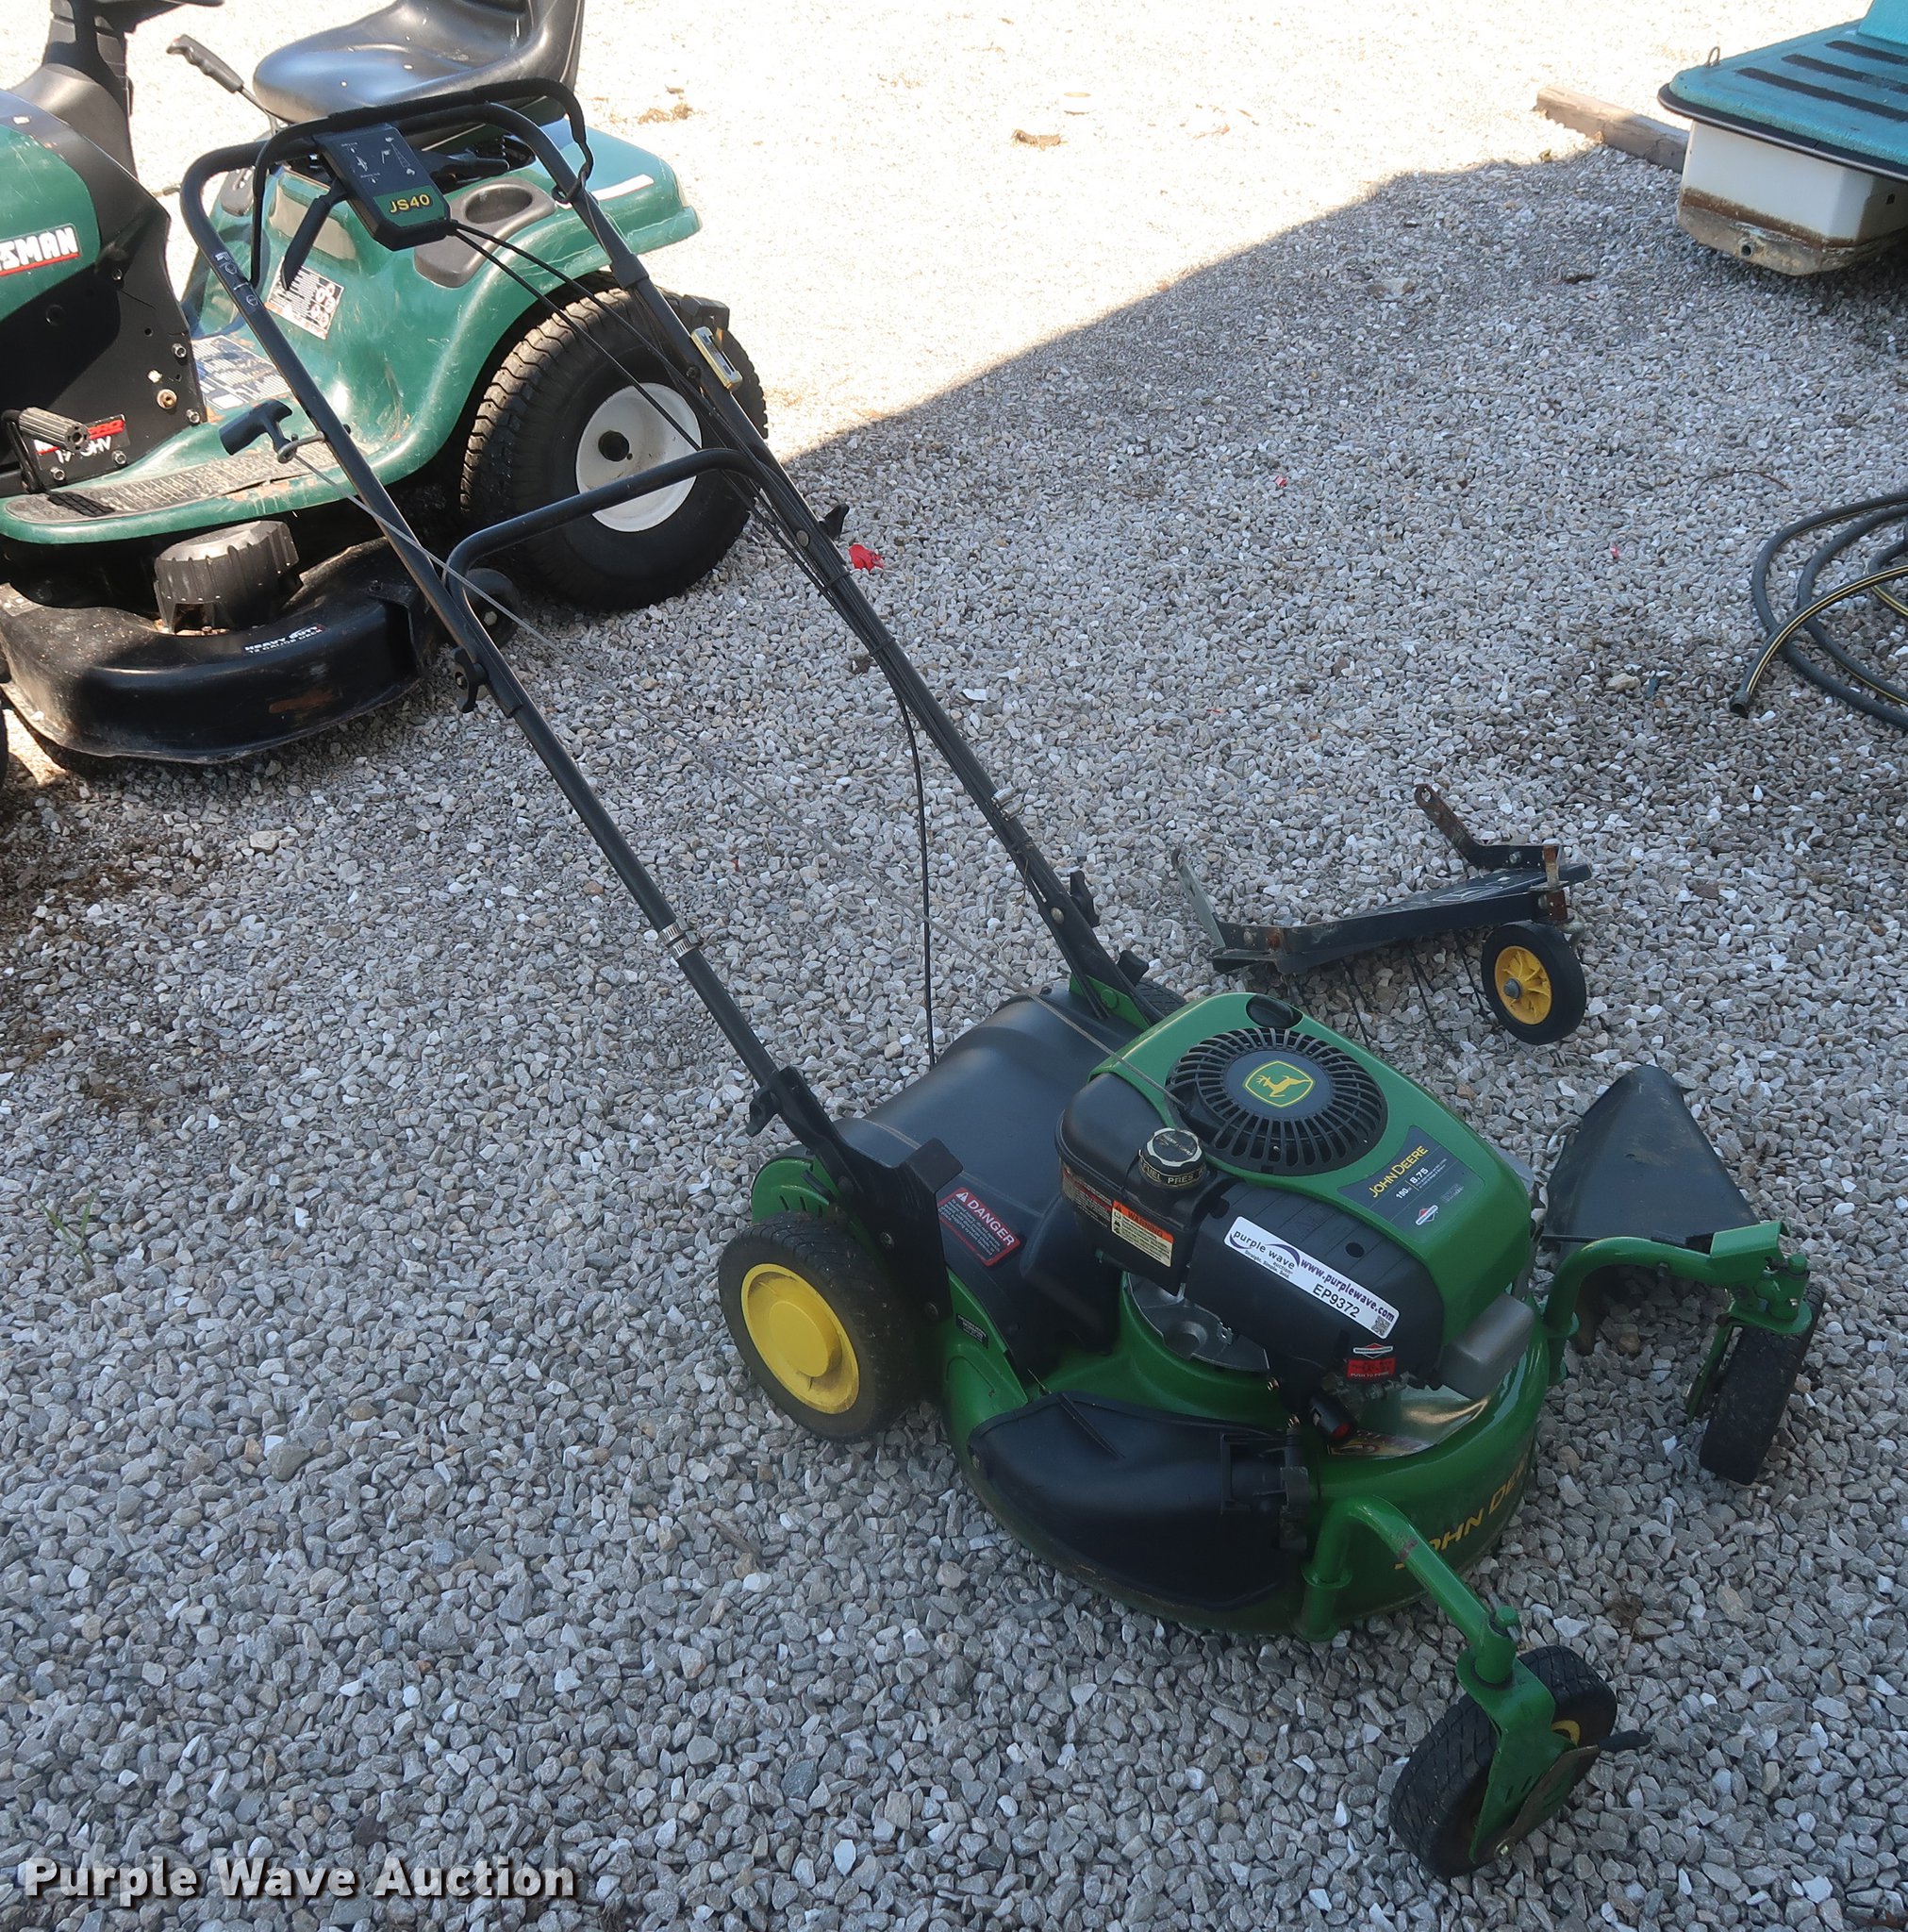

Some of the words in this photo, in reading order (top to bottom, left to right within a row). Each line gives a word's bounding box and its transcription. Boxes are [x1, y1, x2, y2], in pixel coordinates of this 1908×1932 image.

[390, 193, 431, 213] JS40
[1369, 1172, 1399, 1198] JOHN
[1391, 1145, 1429, 1175] DEERE
[967, 1199, 1016, 1246] DANGER
[1233, 1230, 1267, 1254] purple
[1268, 1250, 1296, 1270] wave
[1301, 1258, 1396, 1323] www.purplewave.com
[1312, 1283, 1361, 1319] EP9372
